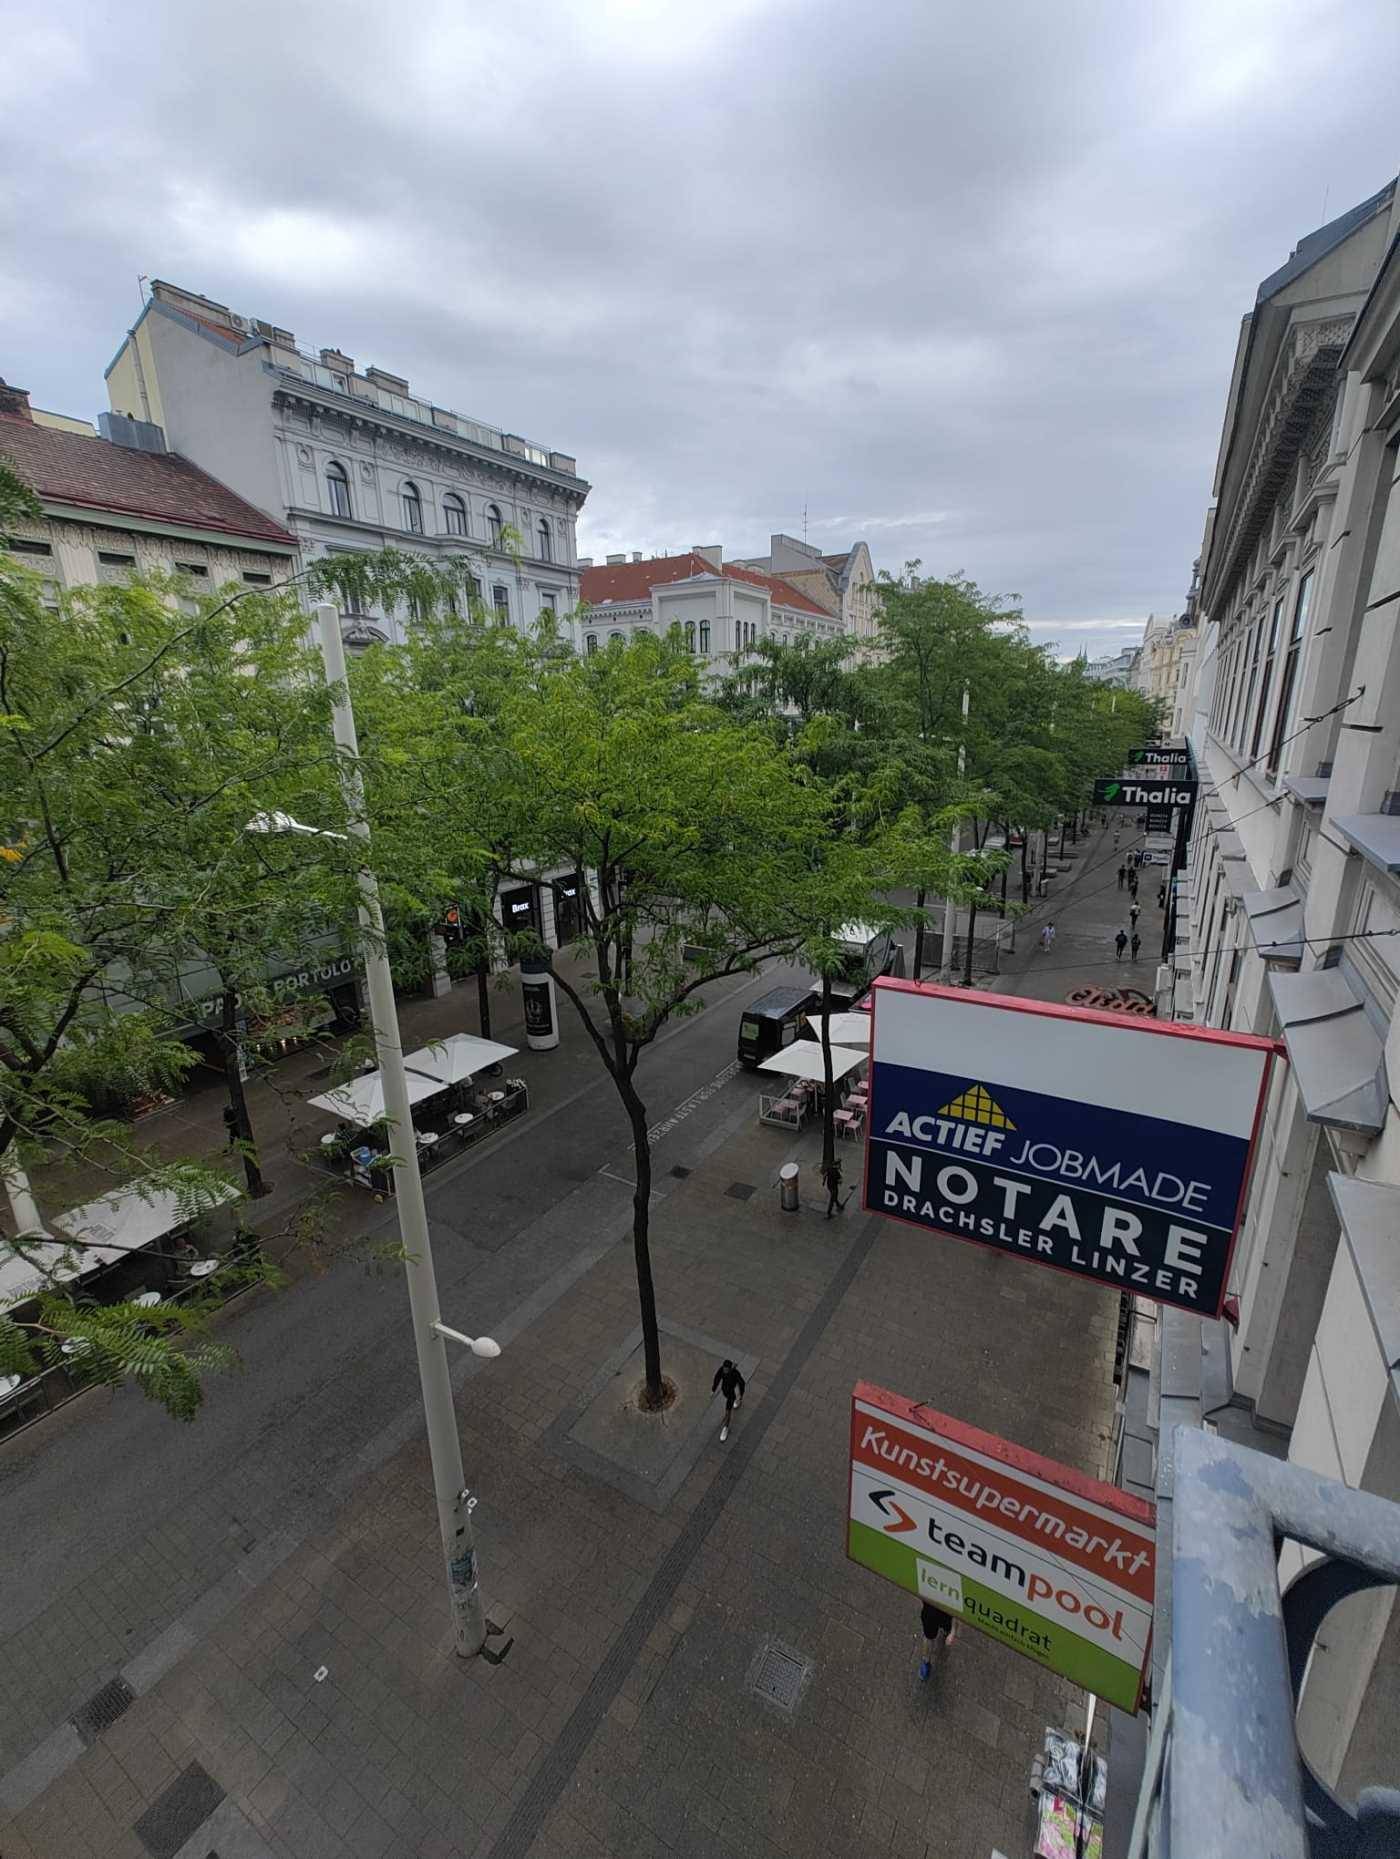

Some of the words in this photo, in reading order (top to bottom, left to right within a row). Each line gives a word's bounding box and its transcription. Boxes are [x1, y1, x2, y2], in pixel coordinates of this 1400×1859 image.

[1122, 786, 1191, 804] Thalia
[1145, 753, 1187, 764] Thalia
[884, 1149, 1208, 1276] NOTARE
[885, 1111, 1006, 1157] ACTIEF
[1009, 1139, 1212, 1213] JOBMADE
[883, 1189, 1054, 1255] DRACHSLER
[1071, 1245, 1200, 1300] LINZER
[860, 1425, 1151, 1576] Kunstsupermarkt
[927, 1518, 1123, 1641] teampool
